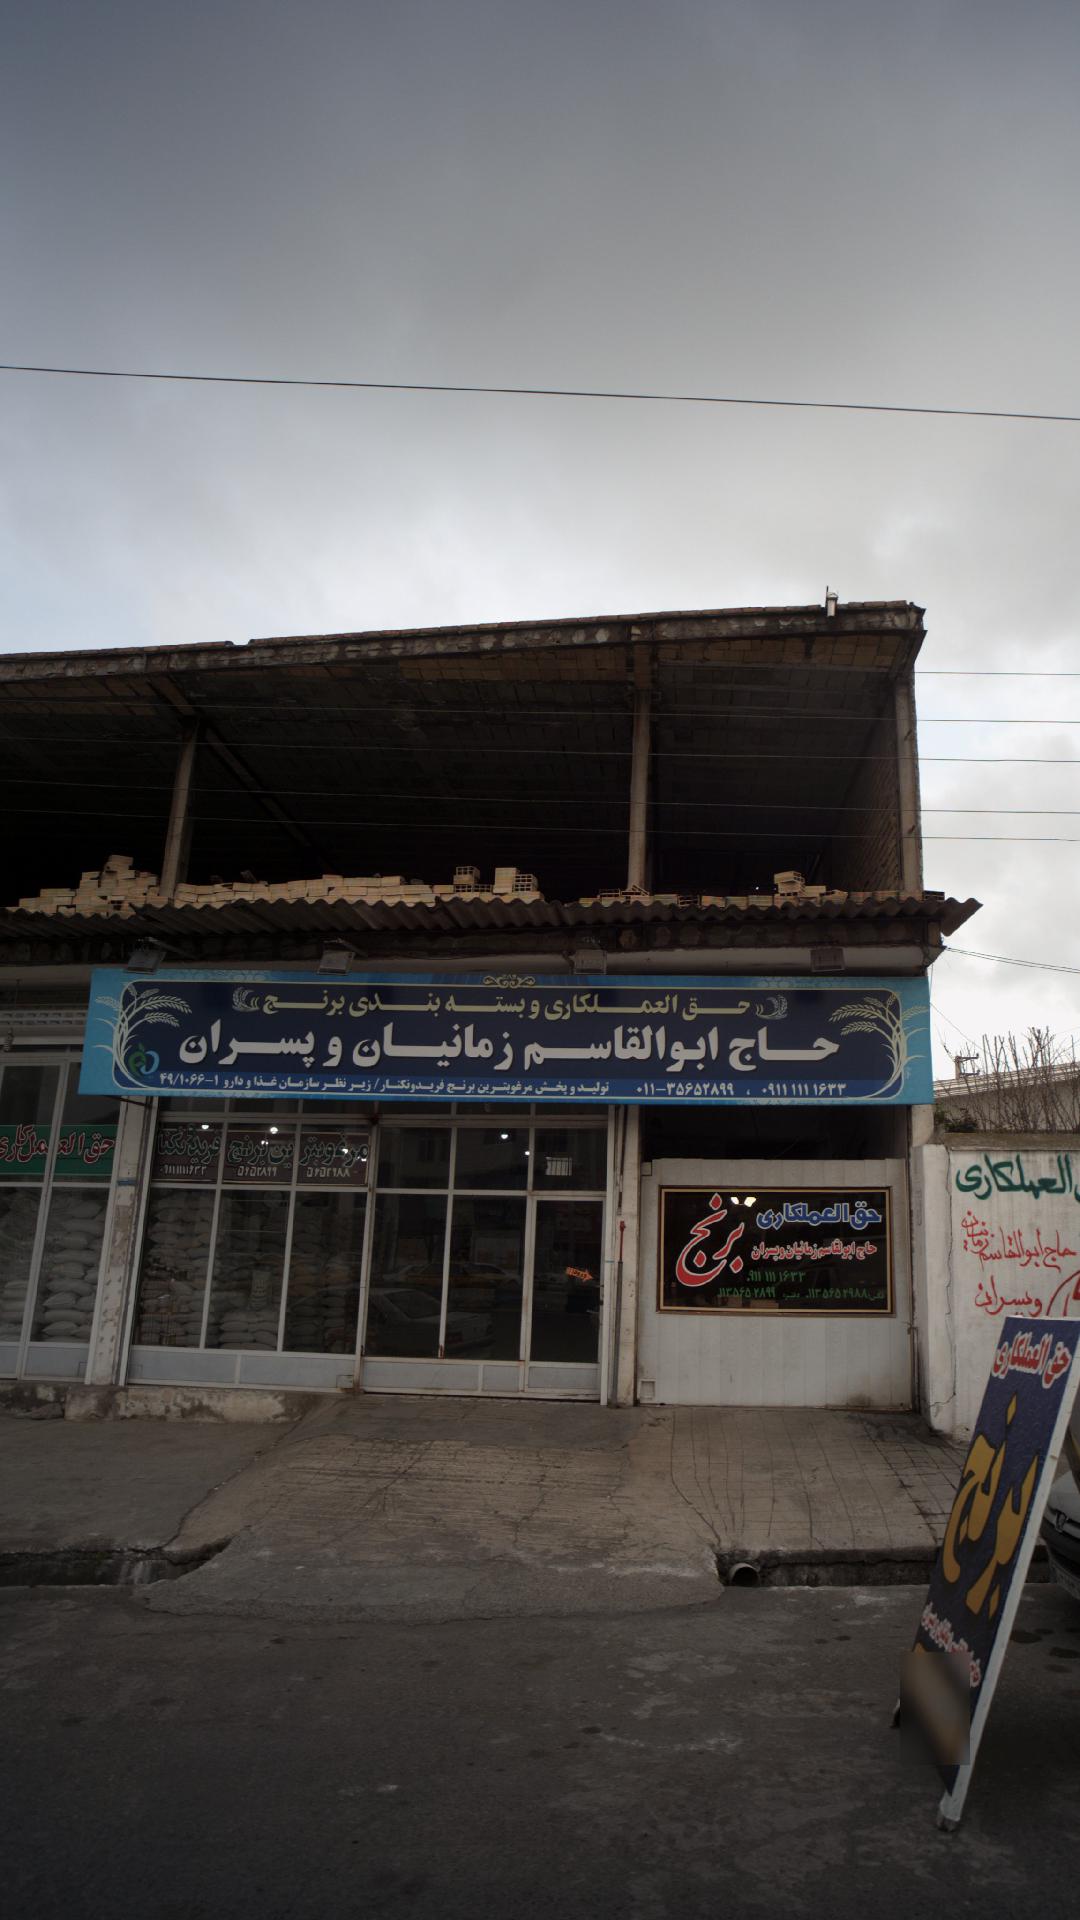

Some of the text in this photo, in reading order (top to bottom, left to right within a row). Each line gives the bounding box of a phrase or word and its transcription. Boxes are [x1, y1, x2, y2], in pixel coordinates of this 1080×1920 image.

[262, 990, 751, 1021] حق العملکاری و بسته بندی برنج
[179, 1018, 841, 1072] حاج ابوالقاسم زمانیان و پسران
[223, 1075, 244, 1089] دارو
[244, 1077, 251, 1089] و
[253, 1075, 278, 1088] غذا
[278, 1076, 320, 1091] سازمان
[322, 1077, 347, 1091] نظر
[348, 1078, 372, 1092] زیر
[379, 1078, 445, 1094] فریدونکنار
[446, 1080, 475, 1094] برنج
[535, 1081, 568, 1095] پخش
[577, 1081, 610, 1095] تولید
[569, 1085, 576, 1095] و
[756, 1201, 882, 1231] حق العملکاری
[676, 1193, 745, 1287] برنج
[856, 1241, 878, 1261] حاج
[1043, 1230, 1077, 1272] حاج
[1041, 1341, 1073, 1389] حق
[942, 1392, 1039, 1622] برنج
